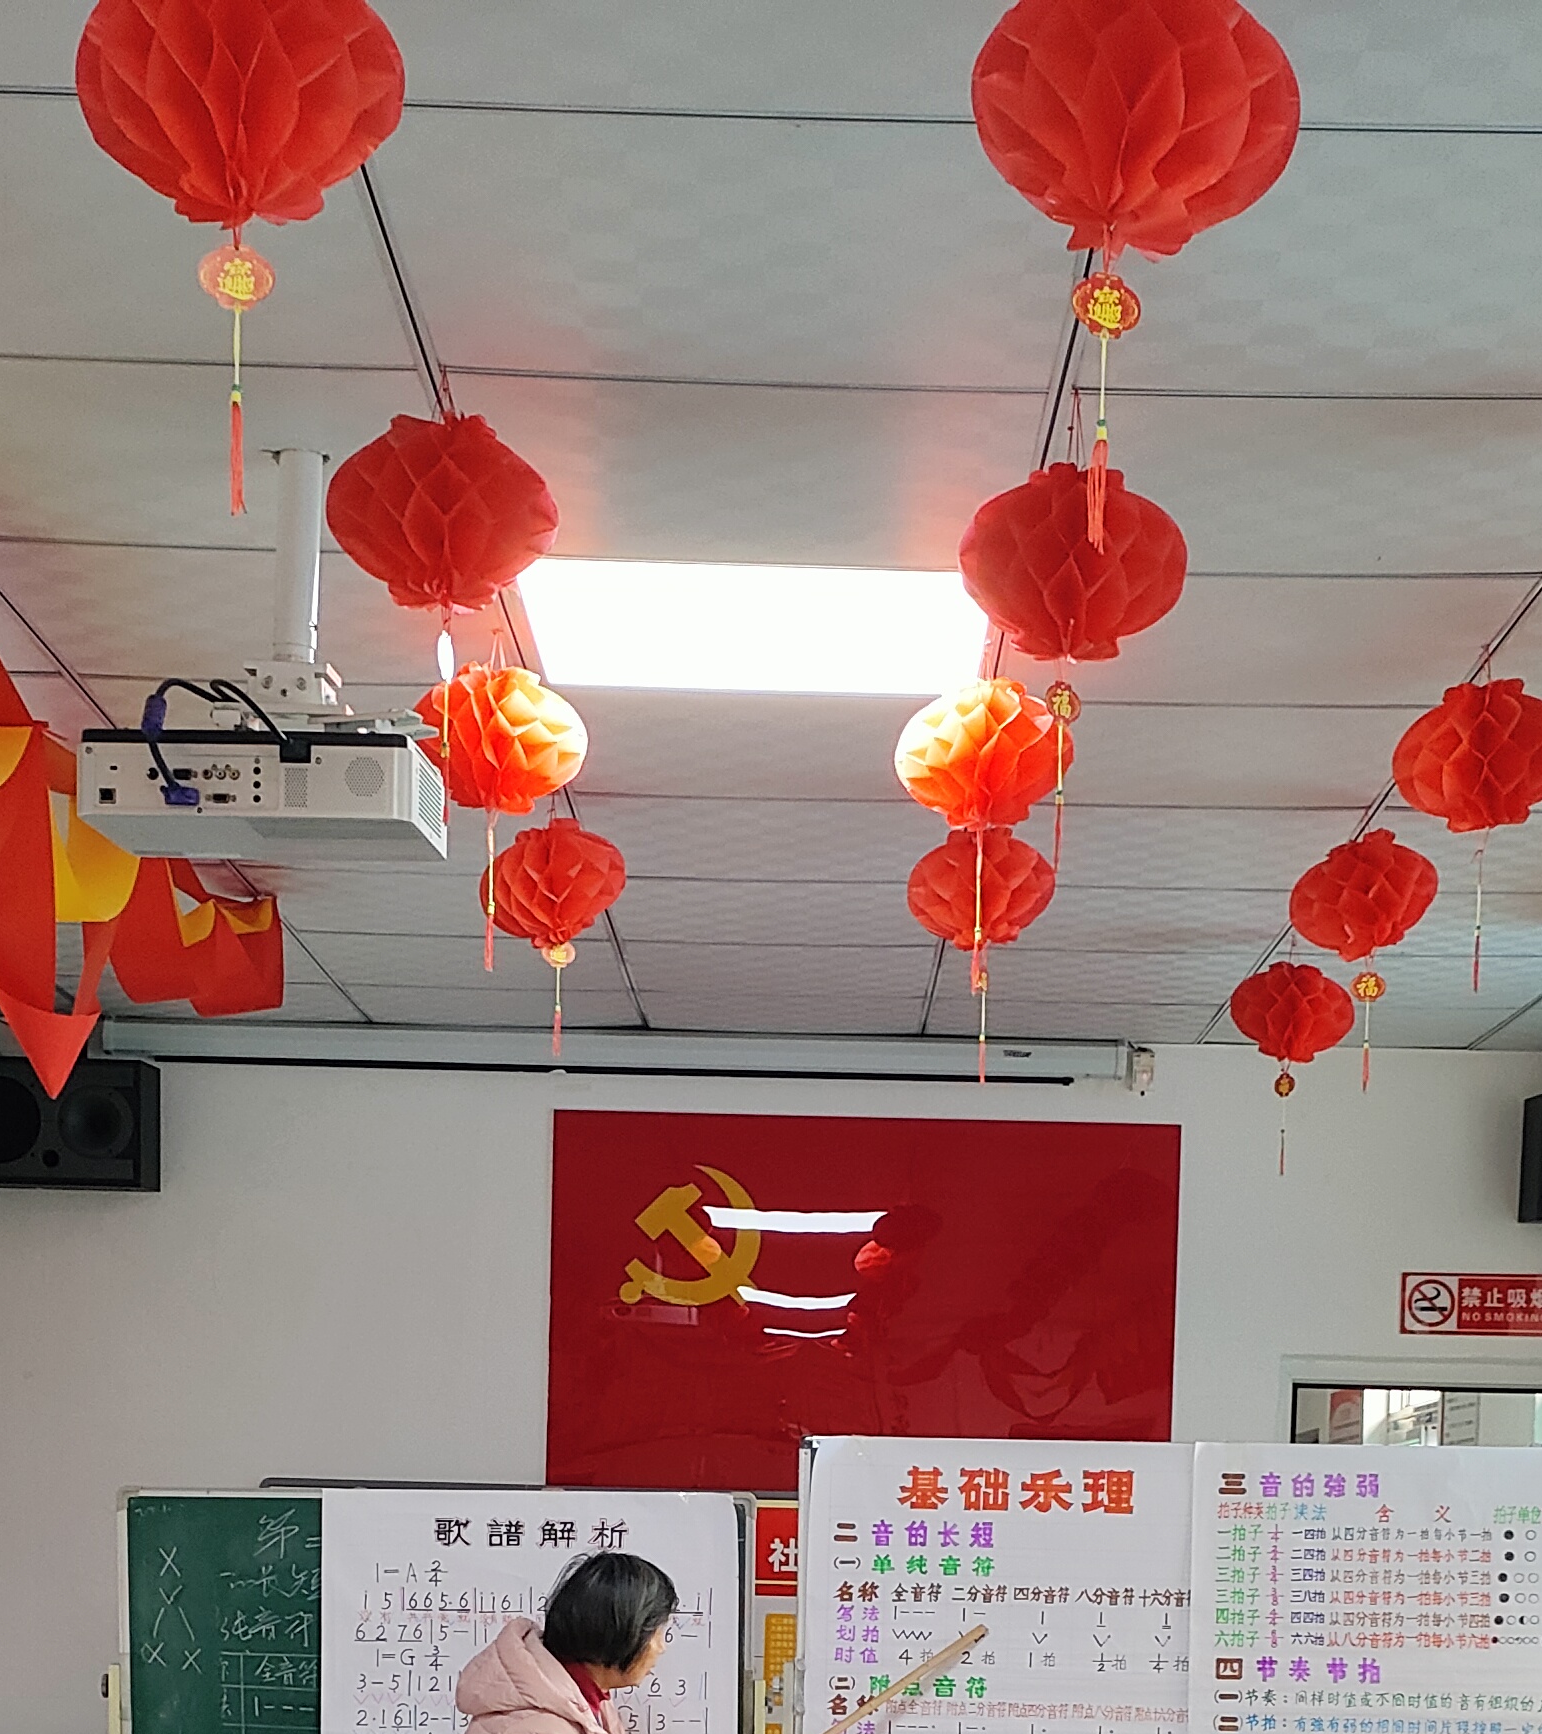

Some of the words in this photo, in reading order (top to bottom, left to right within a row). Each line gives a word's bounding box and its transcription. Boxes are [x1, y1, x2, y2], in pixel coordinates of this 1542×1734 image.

[1051, 688, 1072, 719] 福
[1356, 974, 1379, 997] 福
[1461, 1312, 1481, 1322] NO
[871, 1519, 995, 1549] 音的长短
[1216, 1524, 1263, 1542] 一拍子
[1216, 1545, 1261, 1563] 二拍子
[871, 1553, 996, 1578] 单纯音符
[1215, 1566, 1260, 1584] 三拍子
[833, 1581, 880, 1603] 名称
[892, 1582, 942, 1603] 全音符
[952, 1584, 1008, 1604] 二分音符
[1013, 1586, 1070, 1604] 四分音符
[1075, 1587, 1136, 1606] 八分音符
[1215, 1588, 1260, 1605] 三拍子
[836, 1604, 880, 1622] 写法
[1215, 1608, 1260, 1626] 四拍子
[836, 1625, 880, 1643] 划拍
[1214, 1630, 1260, 1648] 六拍子
[833, 1646, 879, 1664] 时值
